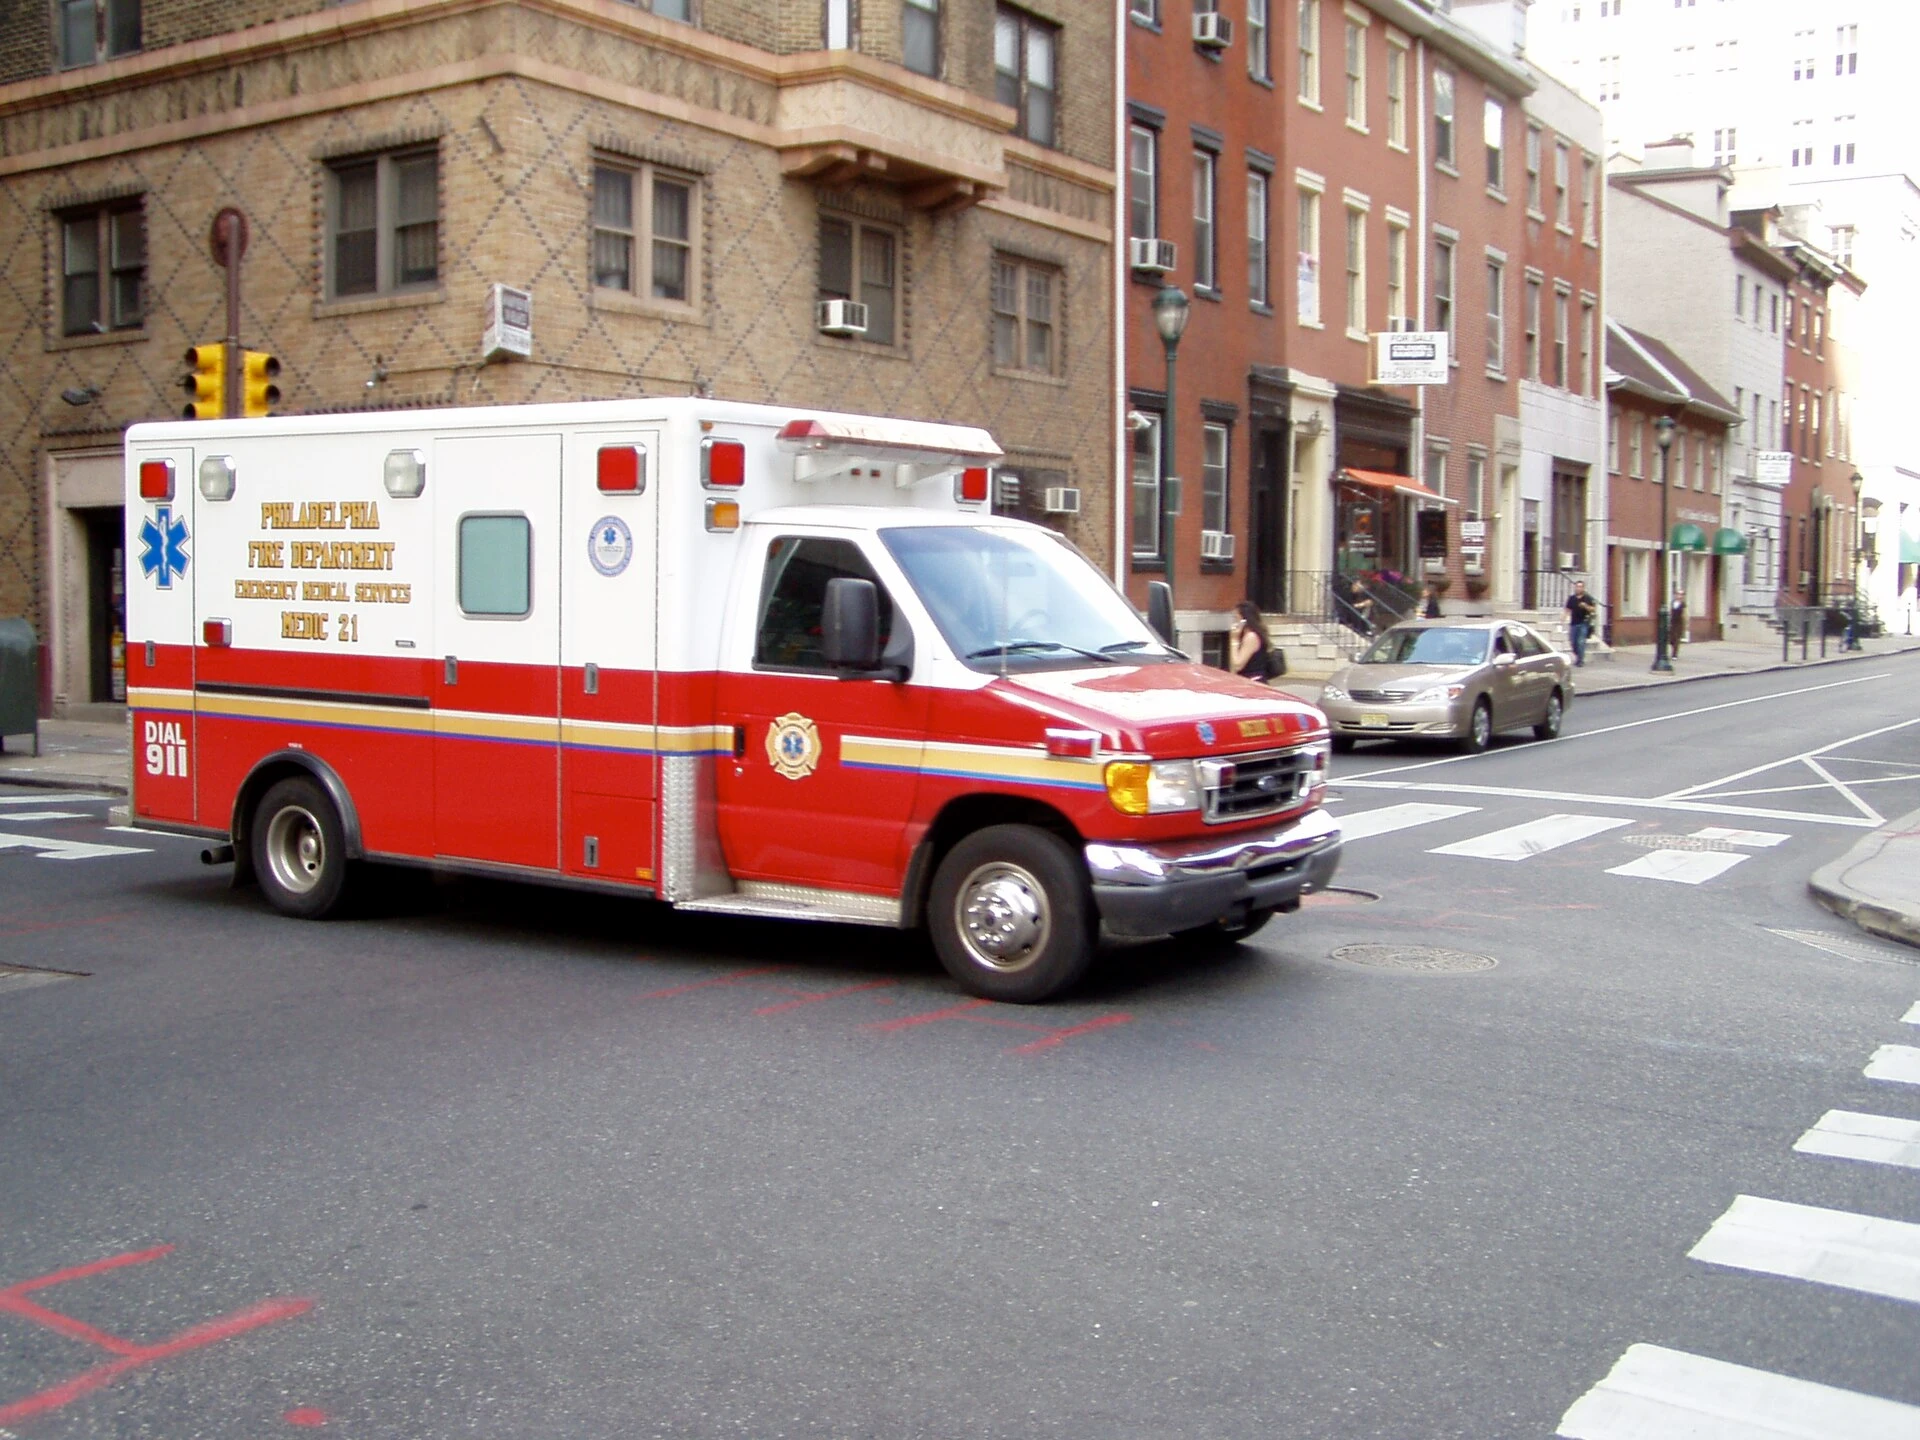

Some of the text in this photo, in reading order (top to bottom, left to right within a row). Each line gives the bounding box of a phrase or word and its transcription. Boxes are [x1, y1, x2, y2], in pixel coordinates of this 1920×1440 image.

[261, 501, 380, 529] PHILADELPHIA
[248, 541, 395, 570] FIRE DEPARTMENT
[235, 579, 412, 604] EMERGENCY MEDICAL SERVICES
[281, 611, 358, 642] MEDIC 21
[145, 720, 187, 746] DIAL
[146, 743, 188, 778] 911
